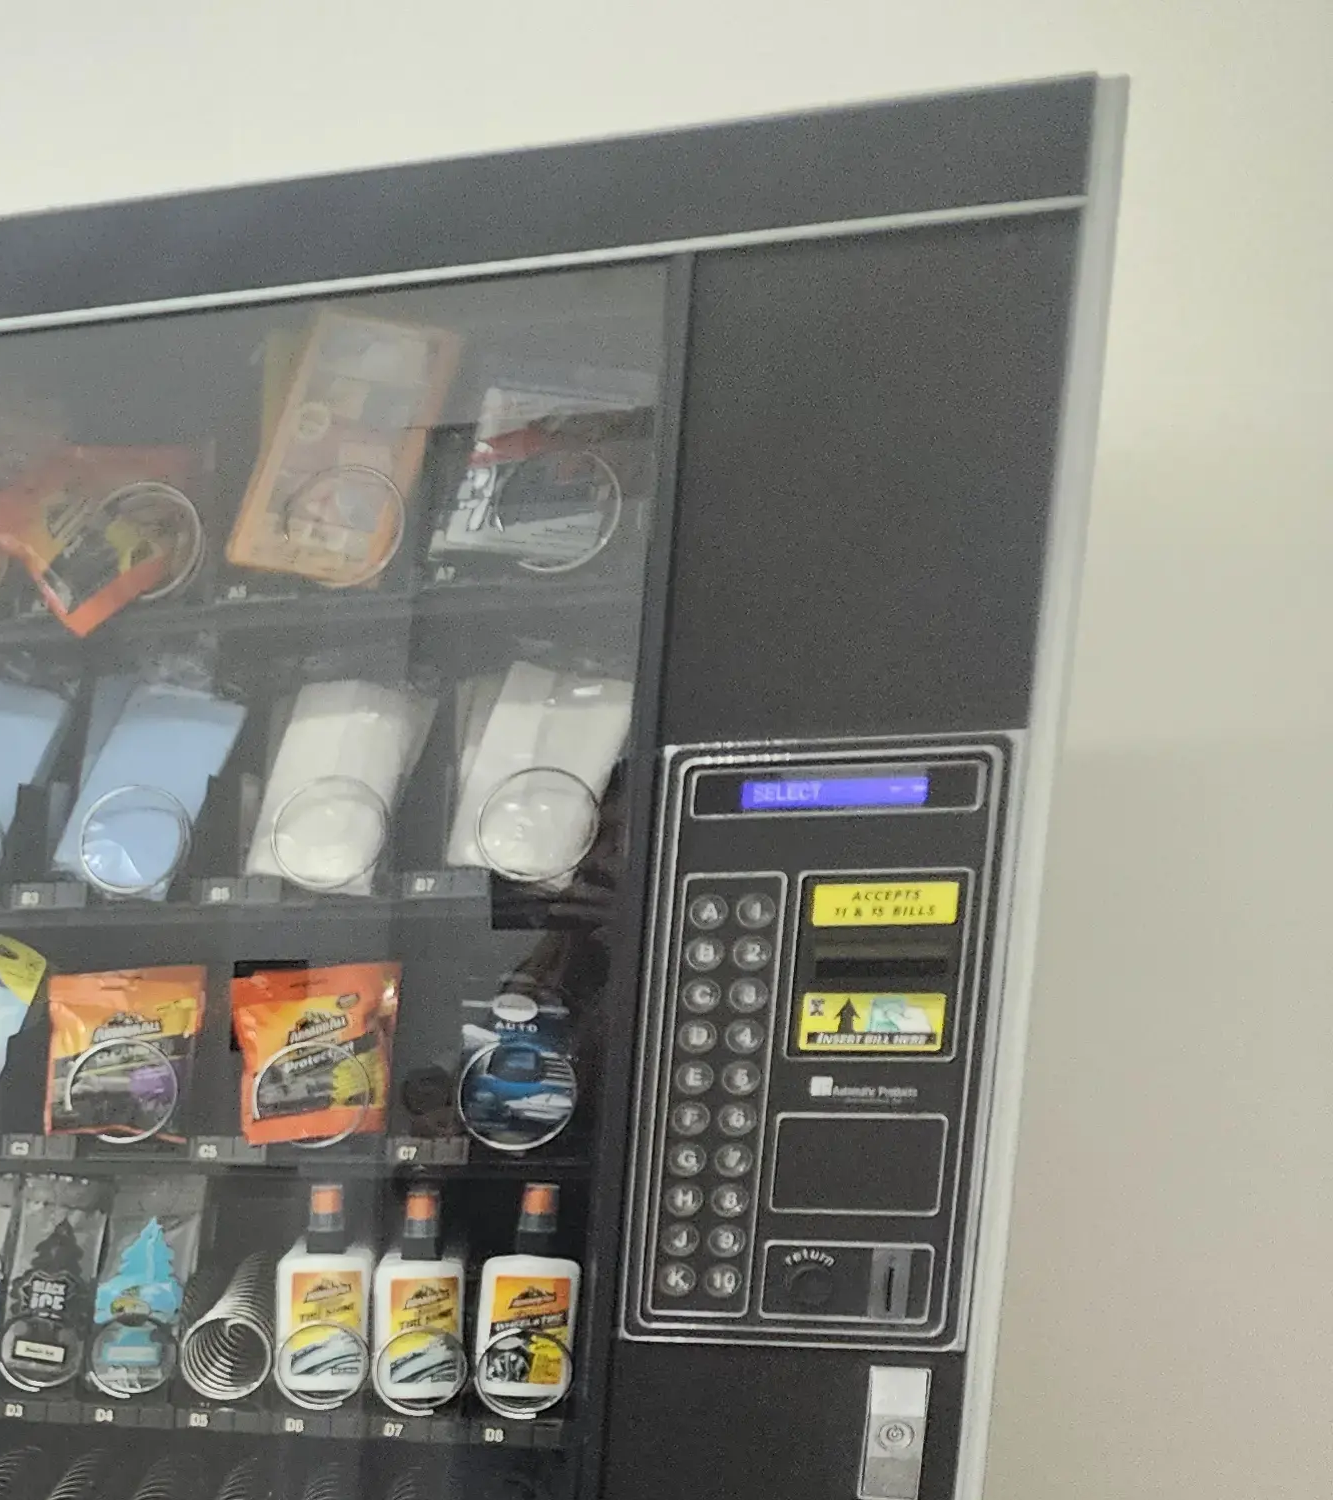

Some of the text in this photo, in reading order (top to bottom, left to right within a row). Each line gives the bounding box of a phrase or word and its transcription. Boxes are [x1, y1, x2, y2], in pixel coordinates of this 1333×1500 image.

[752, 779, 823, 803] SELECT
[851, 889, 923, 902] ACCEPTS
[892, 905, 937, 917] BILLS
[494, 1020, 539, 1033] AUTO
[817, 1032, 863, 1045] INSERT
[878, 1085, 918, 1098] Products
[784, 1247, 836, 1269] return
[383, 1422, 404, 1437] D7
